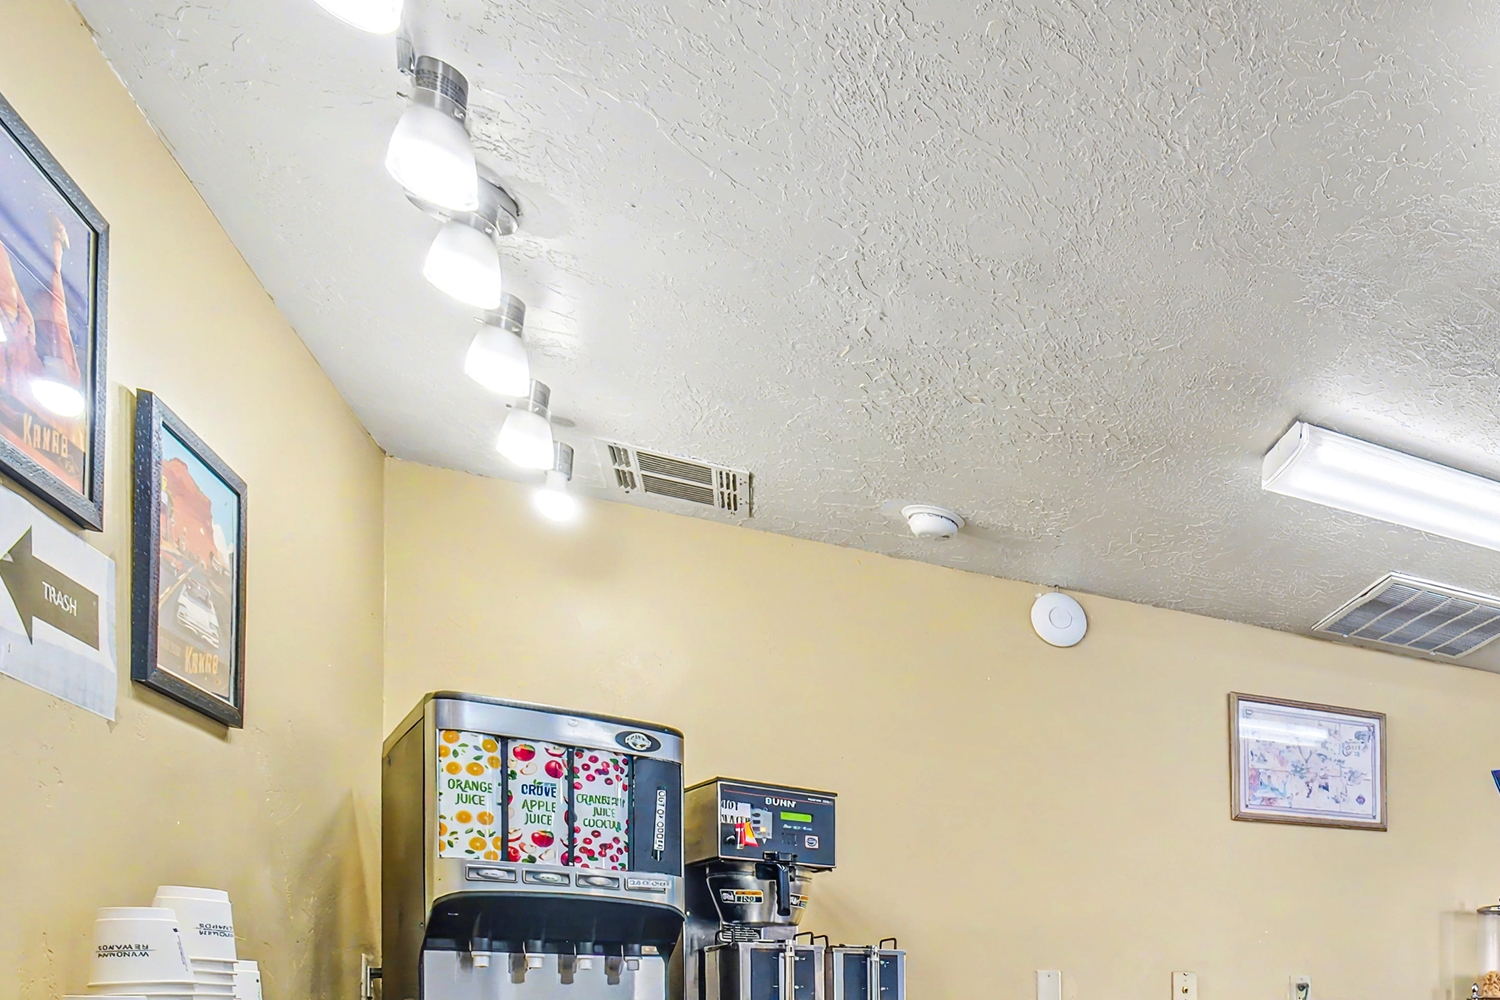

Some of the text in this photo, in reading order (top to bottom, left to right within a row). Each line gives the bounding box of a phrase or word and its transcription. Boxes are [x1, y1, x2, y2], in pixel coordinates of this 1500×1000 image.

[41, 581, 78, 617] TRASH
[447, 778, 493, 793] ORANGE
[455, 793, 486, 806] JUICE
[522, 799, 557, 813] APPLE
[524, 813, 552, 826] JUICE
